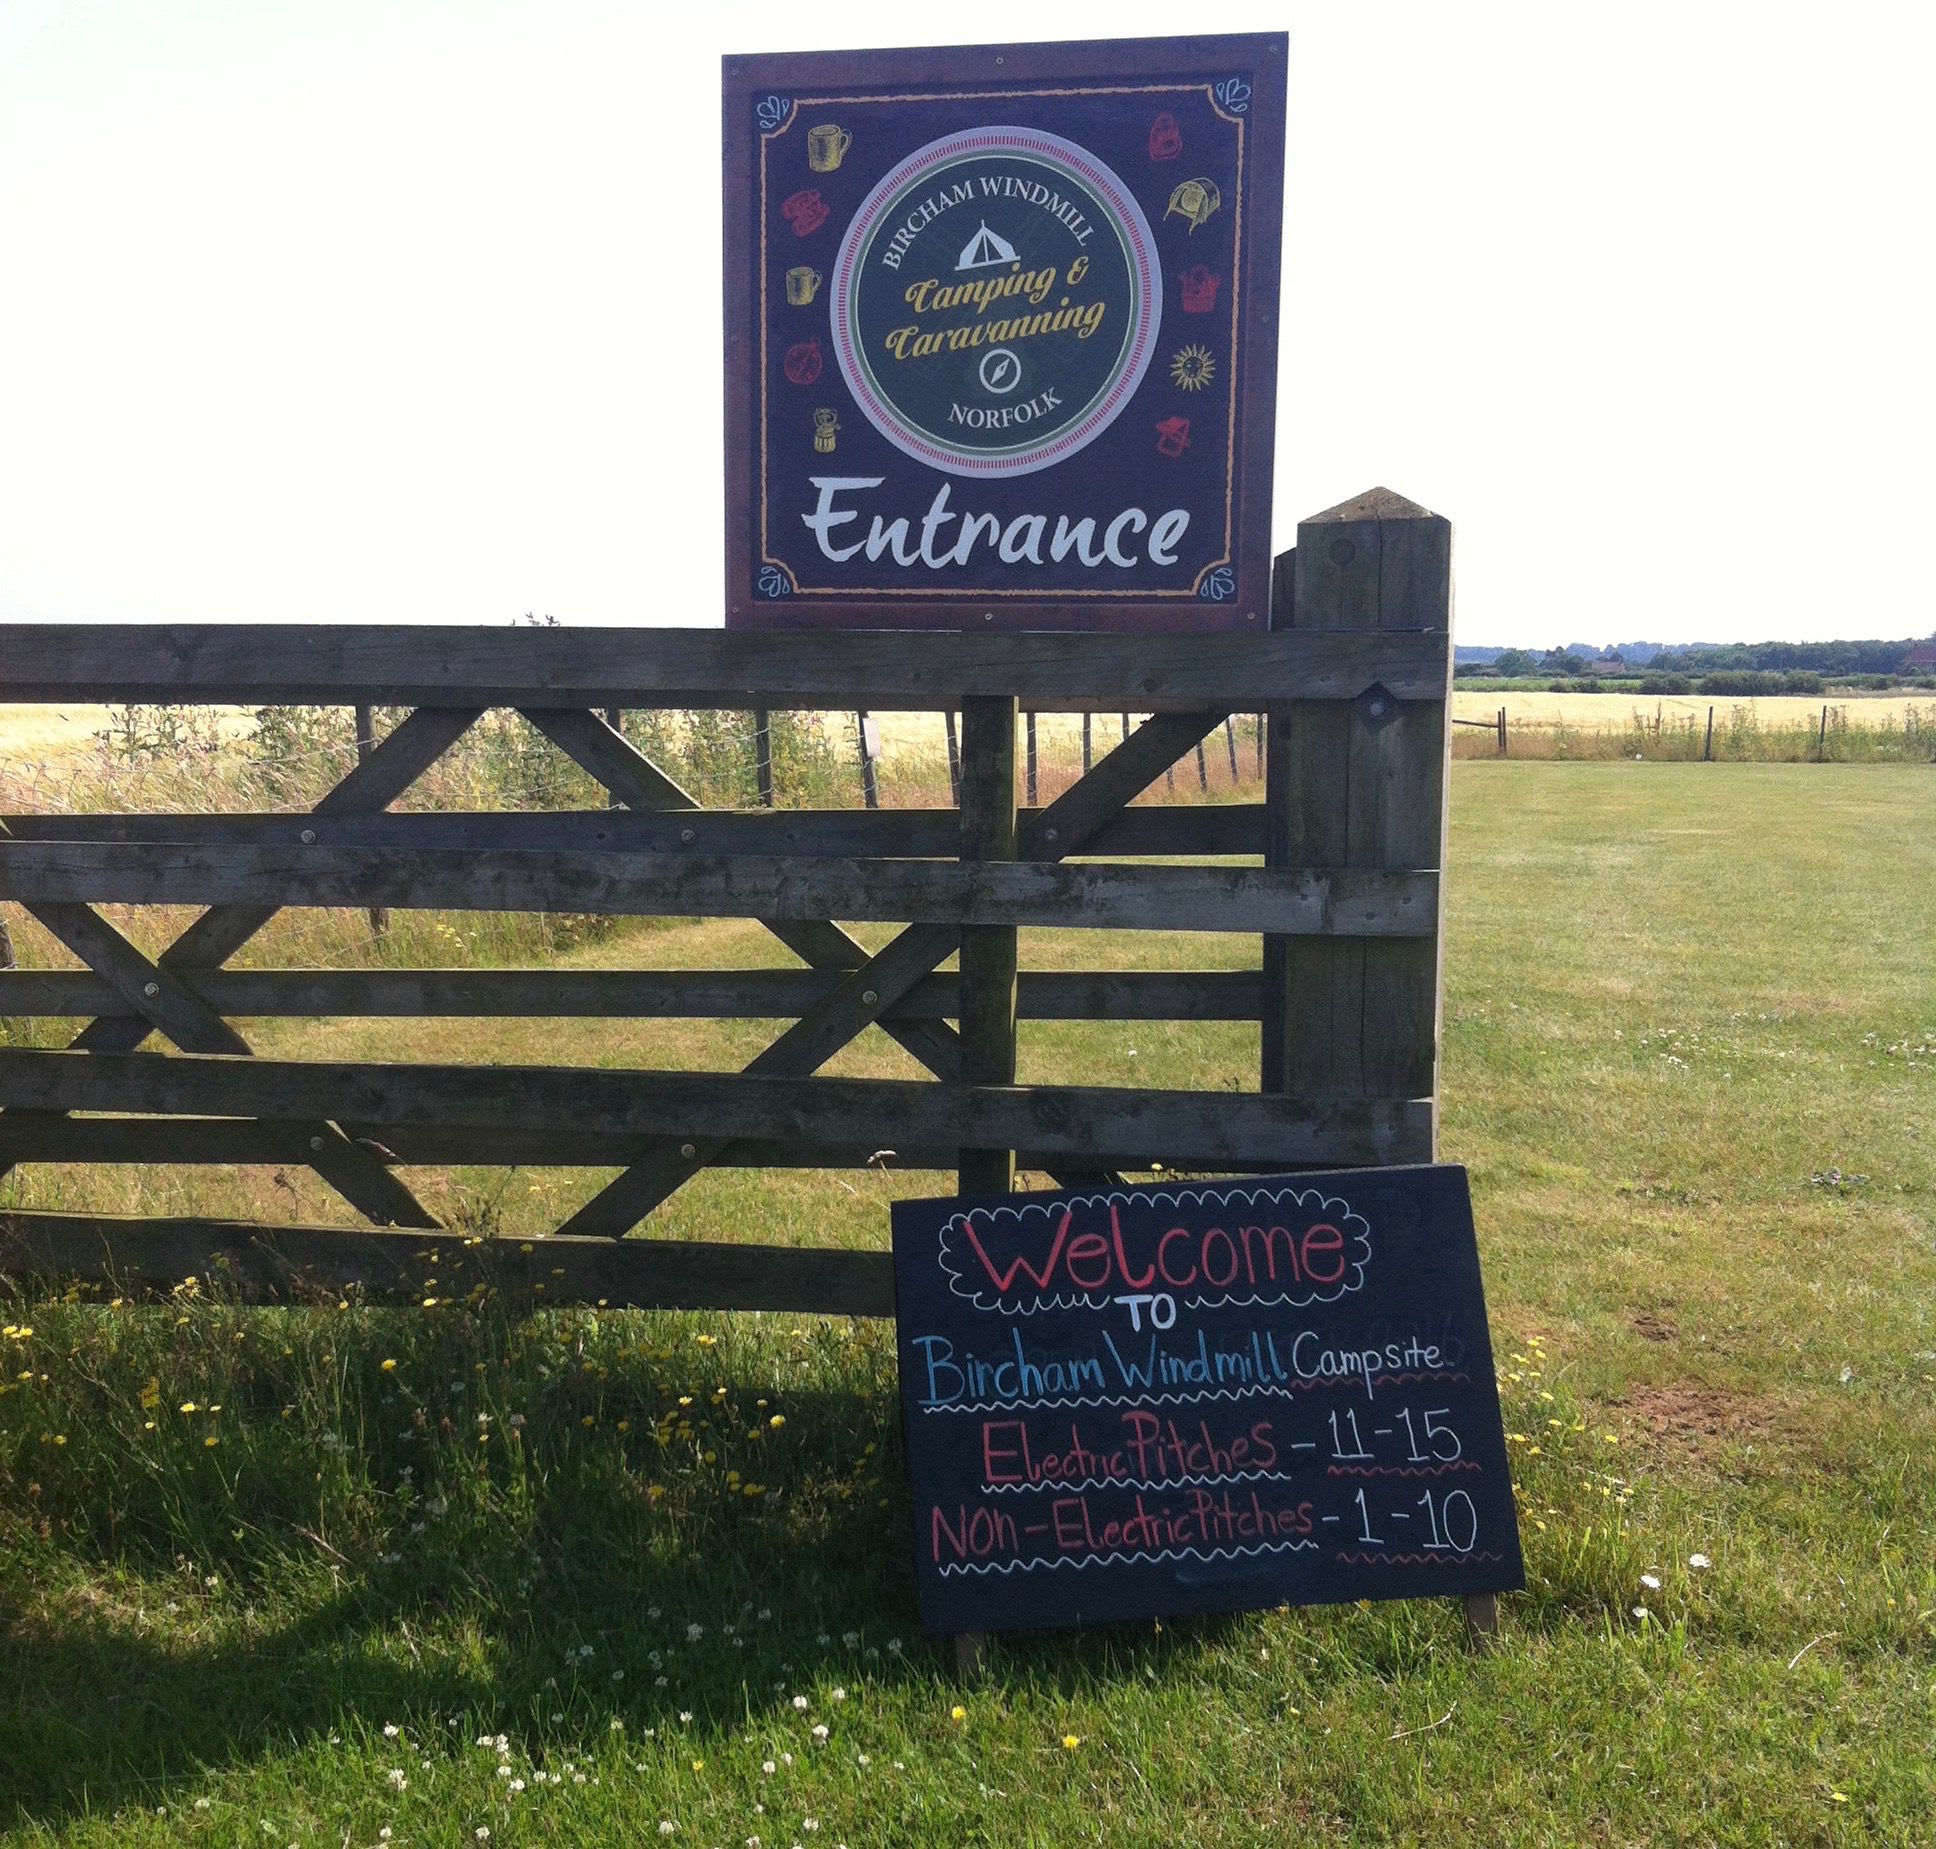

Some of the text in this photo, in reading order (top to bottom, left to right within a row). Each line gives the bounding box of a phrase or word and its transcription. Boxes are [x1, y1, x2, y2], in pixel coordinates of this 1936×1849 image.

[882, 176, 1095, 270] BIRCHAM WINDMILL
[904, 255, 1090, 314] Camping &
[885, 296, 1106, 360] Caravanning
[947, 387, 1062, 428] NORFOLK
[801, 476, 1191, 569] Entrance
[963, 1205, 1345, 1289] Welcome
[1114, 1293, 1177, 1332] TO
[913, 1327, 1105, 1405] Bircham
[1102, 1329, 1288, 1388] Windmill
[982, 1421, 1124, 1483] Electric
[1122, 1410, 1277, 1479] Pitches
[1184, 1488, 1313, 1537] Pitches
